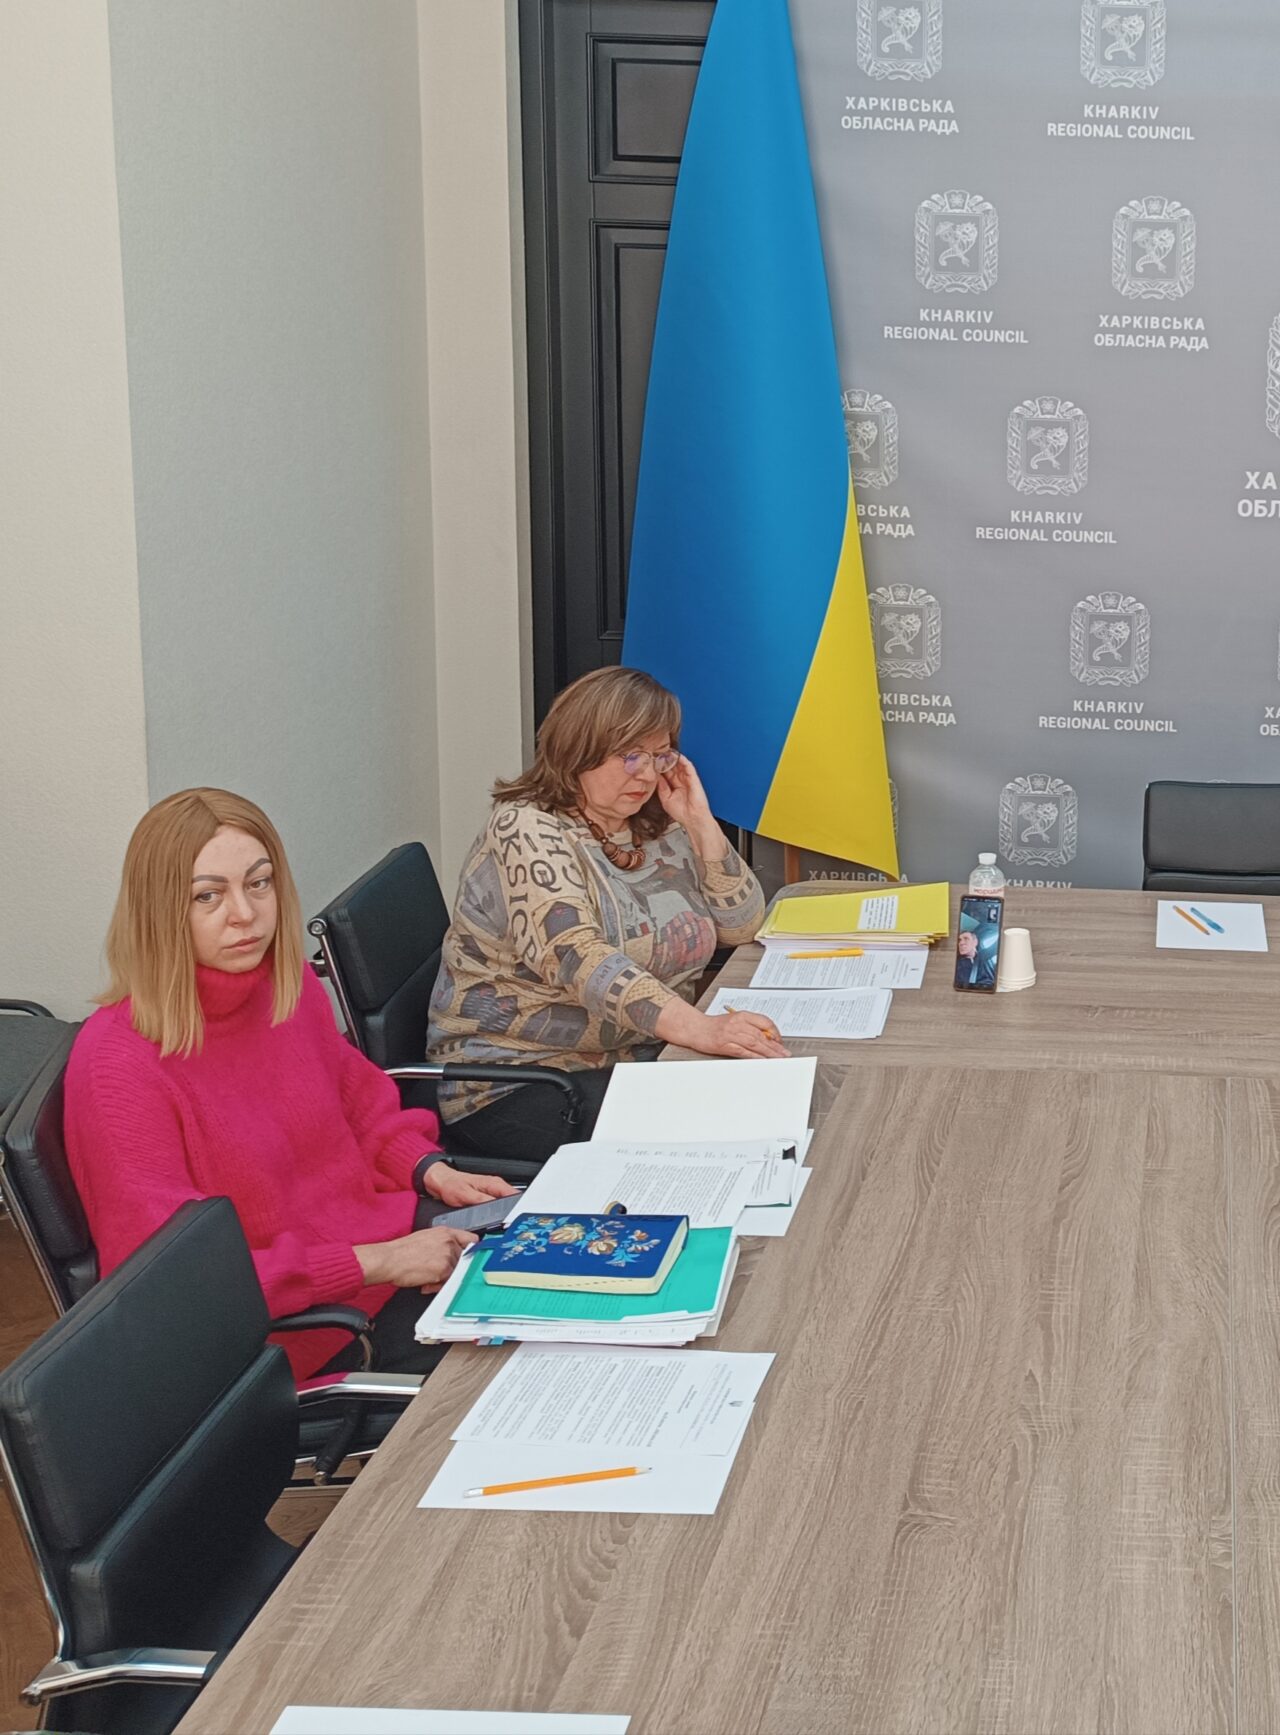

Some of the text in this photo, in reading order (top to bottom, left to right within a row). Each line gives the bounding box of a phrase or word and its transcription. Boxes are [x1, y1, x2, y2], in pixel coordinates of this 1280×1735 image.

[845, 96, 955, 114] ХАРКІВСЬКА
[1083, 104, 1160, 120] KHARKIV
[841, 115, 960, 136] ОБЛАСНА РАДА
[1047, 122, 1195, 141] REGIONAL COUNCIL
[919, 308, 994, 324] KHARKIV
[1098, 314, 1206, 331] ХАРКІВСЬКА
[883, 325, 1029, 344] REGIONAL COUNCIL
[1093, 333, 1209, 352] ОБЛАСНА РАДА
[856, 503, 911, 518] ВСЬКА
[1010, 510, 1083, 525] KHARKIV
[876, 522, 915, 538] РАДА
[975, 526, 1117, 544] REGIONAL COUNCIL
[878, 692, 953, 708] КІВСЬКА
[1073, 699, 1145, 714] KHARKIV
[880, 710, 957, 727] АСНА РАДА
[1038, 715, 1178, 733] REGIONAL COUNCIL
[808, 870, 909, 884] ХАРКІВСЬА
